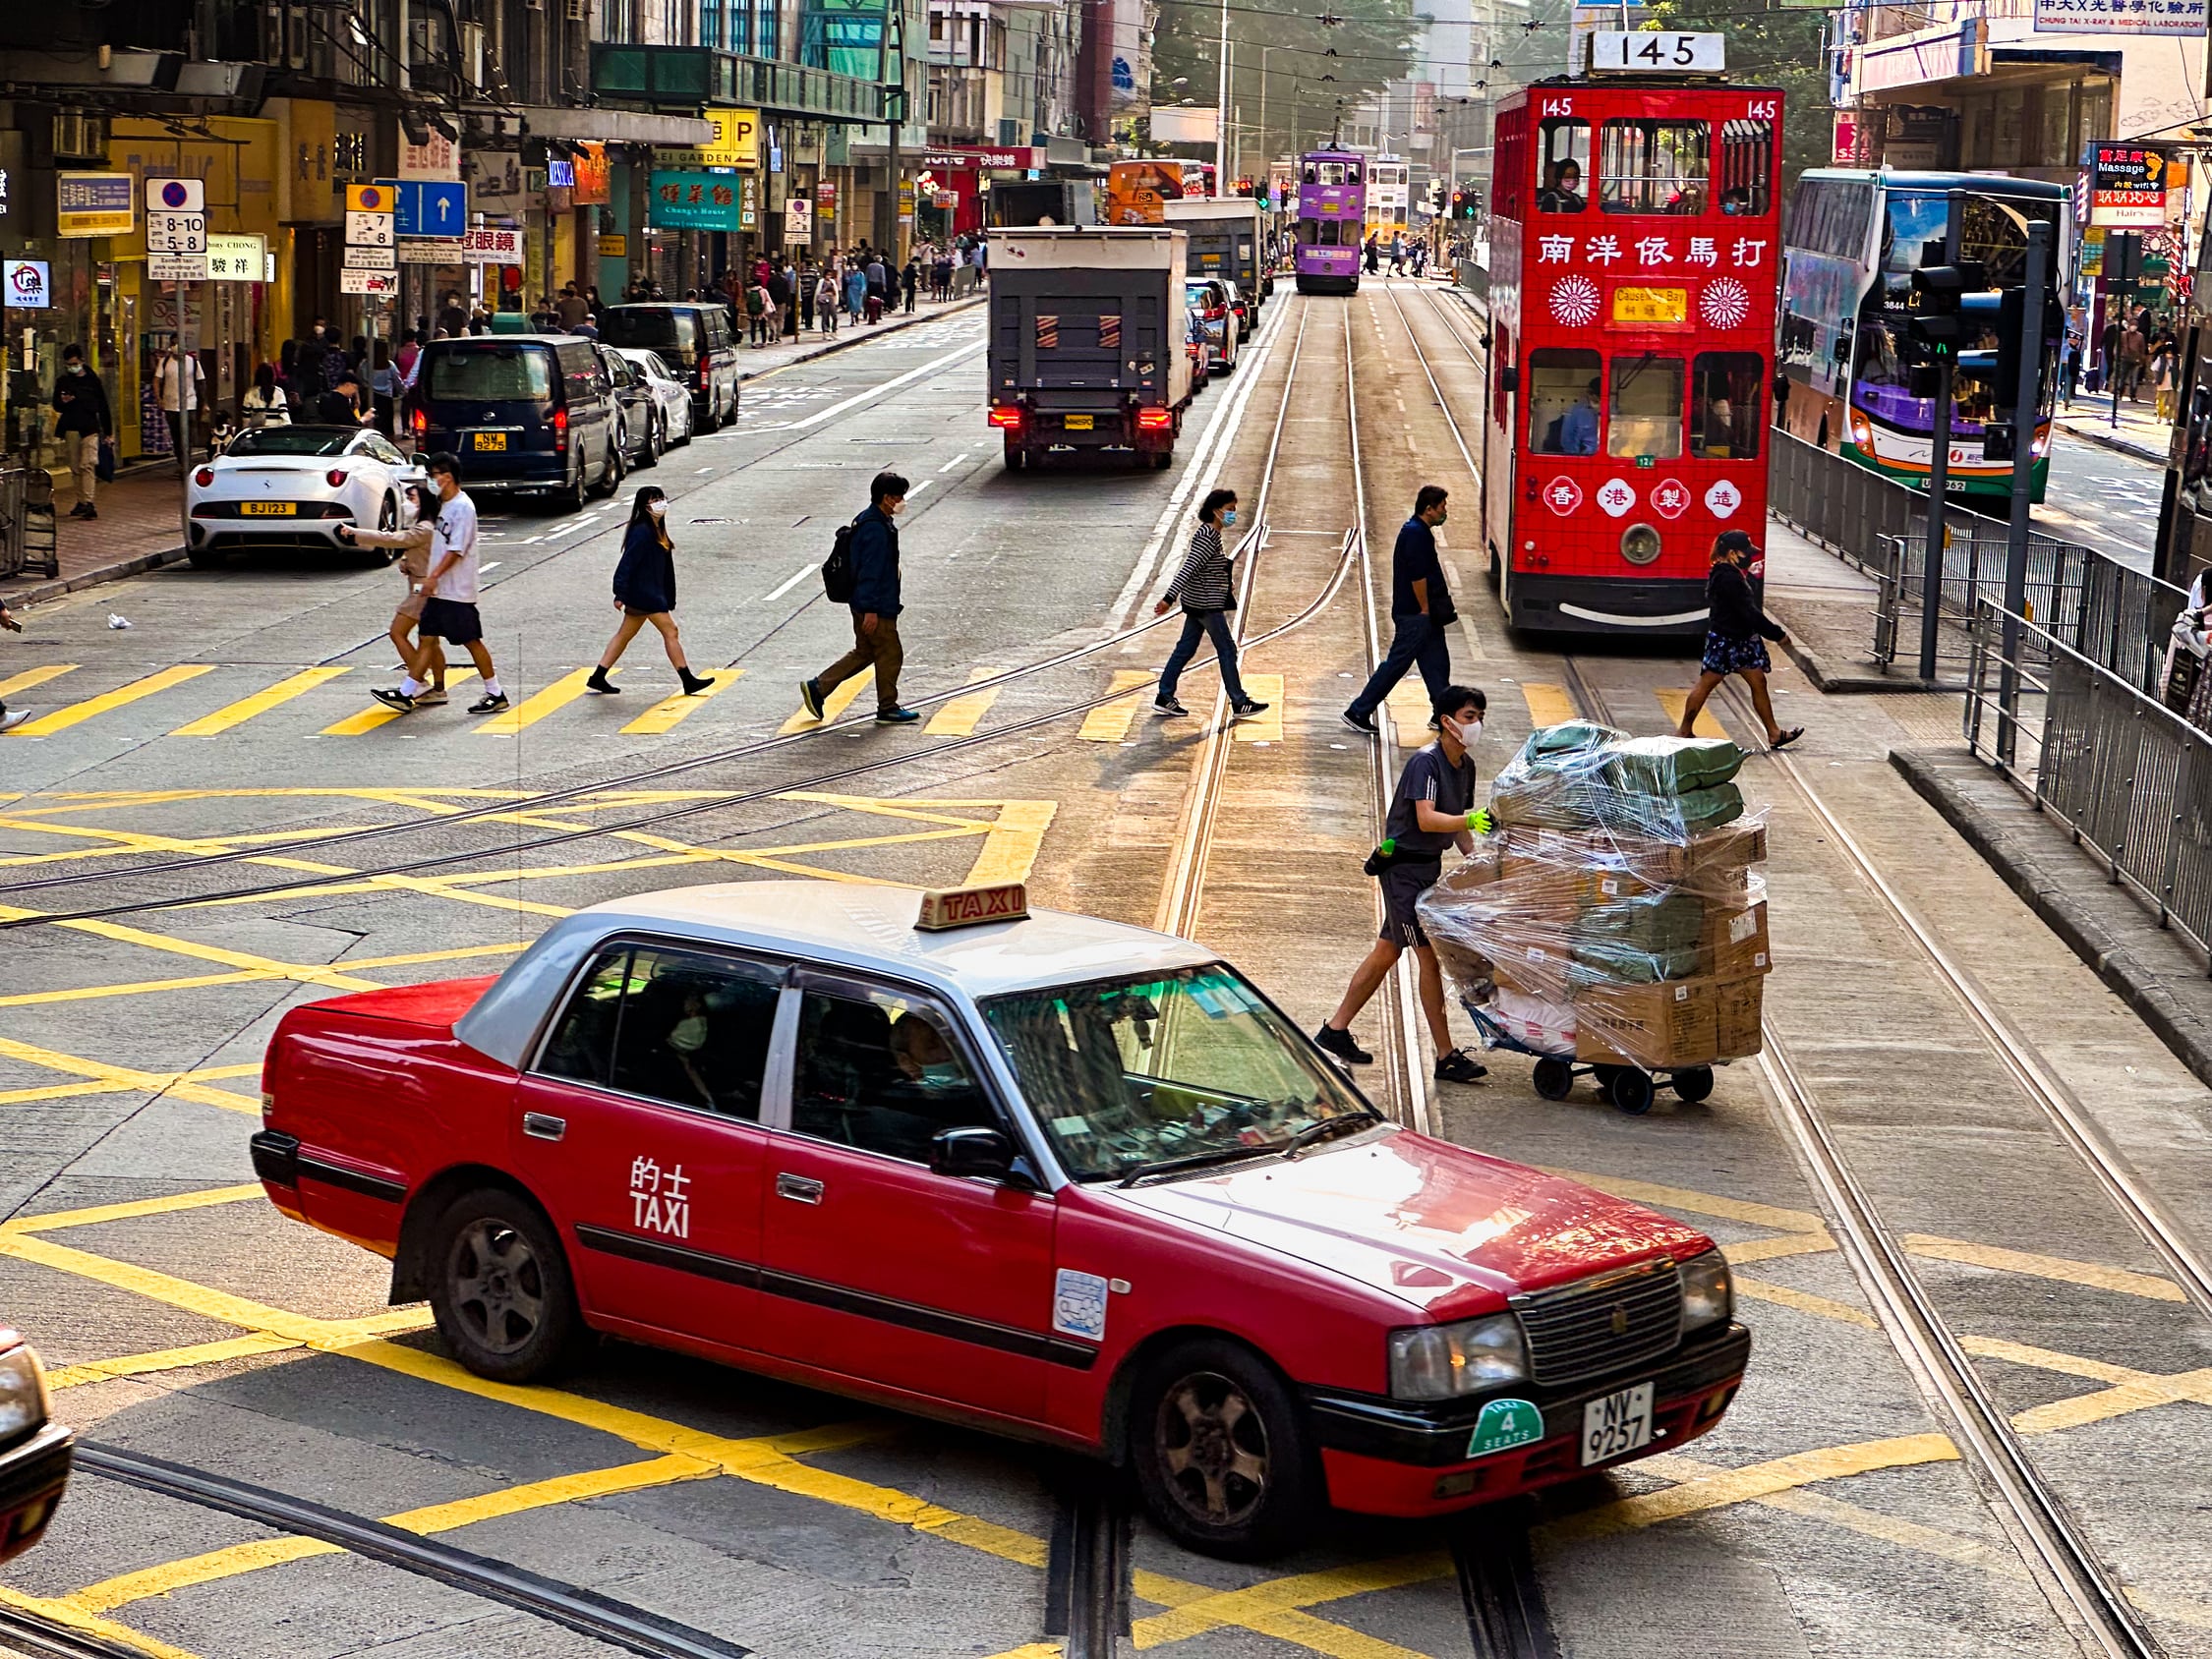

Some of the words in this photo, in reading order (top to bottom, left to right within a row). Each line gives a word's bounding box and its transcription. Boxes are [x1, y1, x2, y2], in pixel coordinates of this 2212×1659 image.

[2119, 18, 2151, 27] MEDICAL
[2154, 20, 2203, 29] LABORATORY
[1622, 36, 1695, 66] 145
[1543, 97, 1572, 116] 145
[1748, 100, 1776, 119] 145
[738, 122, 752, 142] P
[679, 152, 732, 163] GARDEN
[2098, 163, 2144, 175] Massage
[167, 217, 203, 232] 8-10
[378, 215, 385, 226] 7
[378, 232, 386, 244] 8
[1538, 234, 1767, 267] 南洋依馬打
[211, 258, 249, 273] 駿祥
[1666, 291, 1683, 304] Bay
[1884, 300, 1904, 311] 3844
[477, 441, 504, 450] 9275
[1550, 486, 1732, 509] 香港製造
[251, 503, 286, 514] BJ123
[943, 886, 1023, 921] TAXI
[630, 1155, 691, 1201] 的士
[629, 1190, 689, 1239] TAXI
[1603, 1391, 1632, 1427] NV
[1499, 1410, 1516, 1433] 4
[1484, 1430, 1531, 1451] SEATS
[1589, 1414, 1645, 1459] 9257
